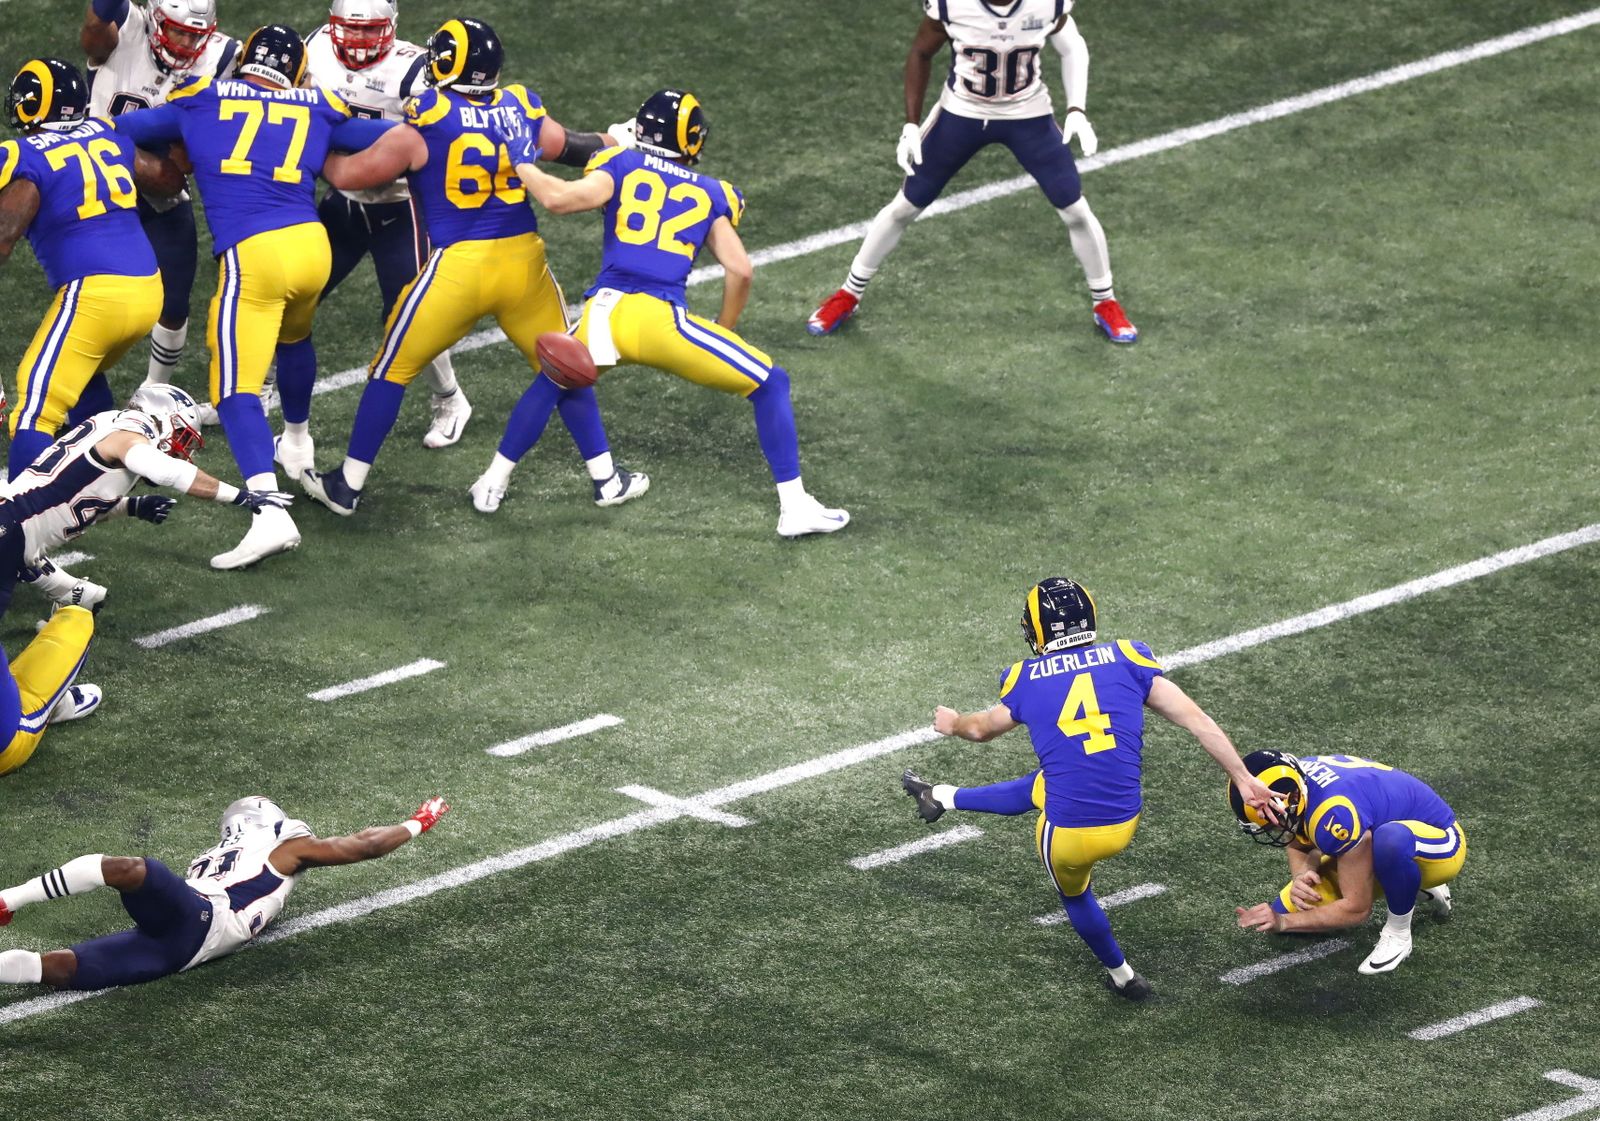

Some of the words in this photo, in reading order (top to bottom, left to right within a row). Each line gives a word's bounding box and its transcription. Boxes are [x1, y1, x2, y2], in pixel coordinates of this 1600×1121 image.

[961, 46, 1040, 98] 30
[44, 138, 137, 220] 76
[219, 99, 310, 184] 77
[445, 132, 526, 209] 66
[644, 154, 700, 182] MUNDT
[615, 168, 712, 262] 82
[1029, 647, 1116, 680] ZUERLEIN
[1069, 633, 1092, 643] ANGELES
[1057, 672, 1116, 755] 4
